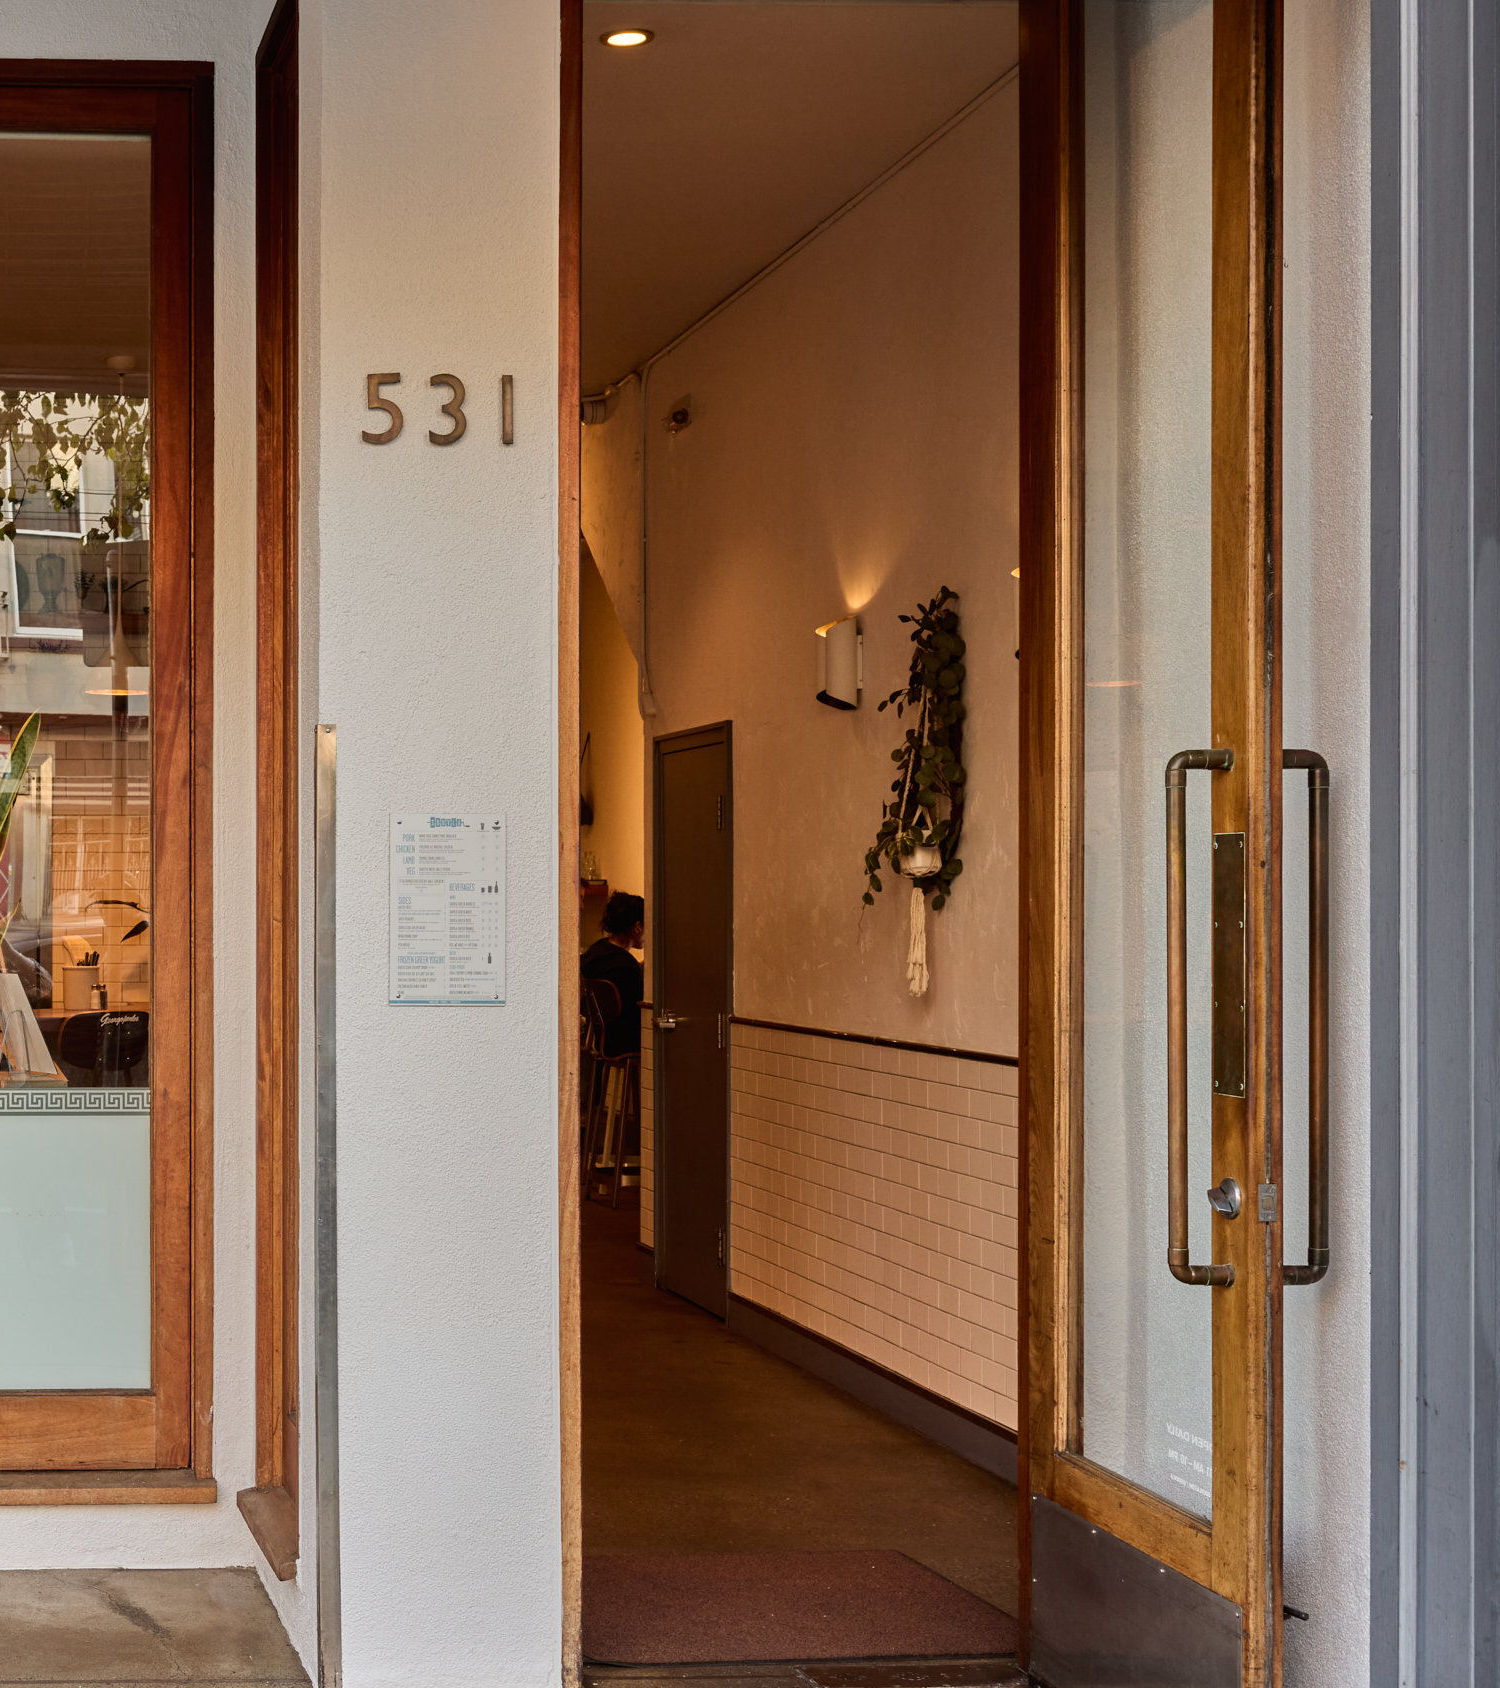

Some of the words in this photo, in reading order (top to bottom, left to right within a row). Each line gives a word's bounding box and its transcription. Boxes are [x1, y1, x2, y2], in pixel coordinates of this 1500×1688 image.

[361, 372, 514, 445] 531
[402, 834, 416, 842] PORK
[395, 845, 416, 853] CHICKEN
[402, 856, 416, 864] LAMB
[449, 883, 476, 891] BEVERAGES
[397, 956, 414, 964] FROZEN
[415, 956, 429, 964] GREEK
